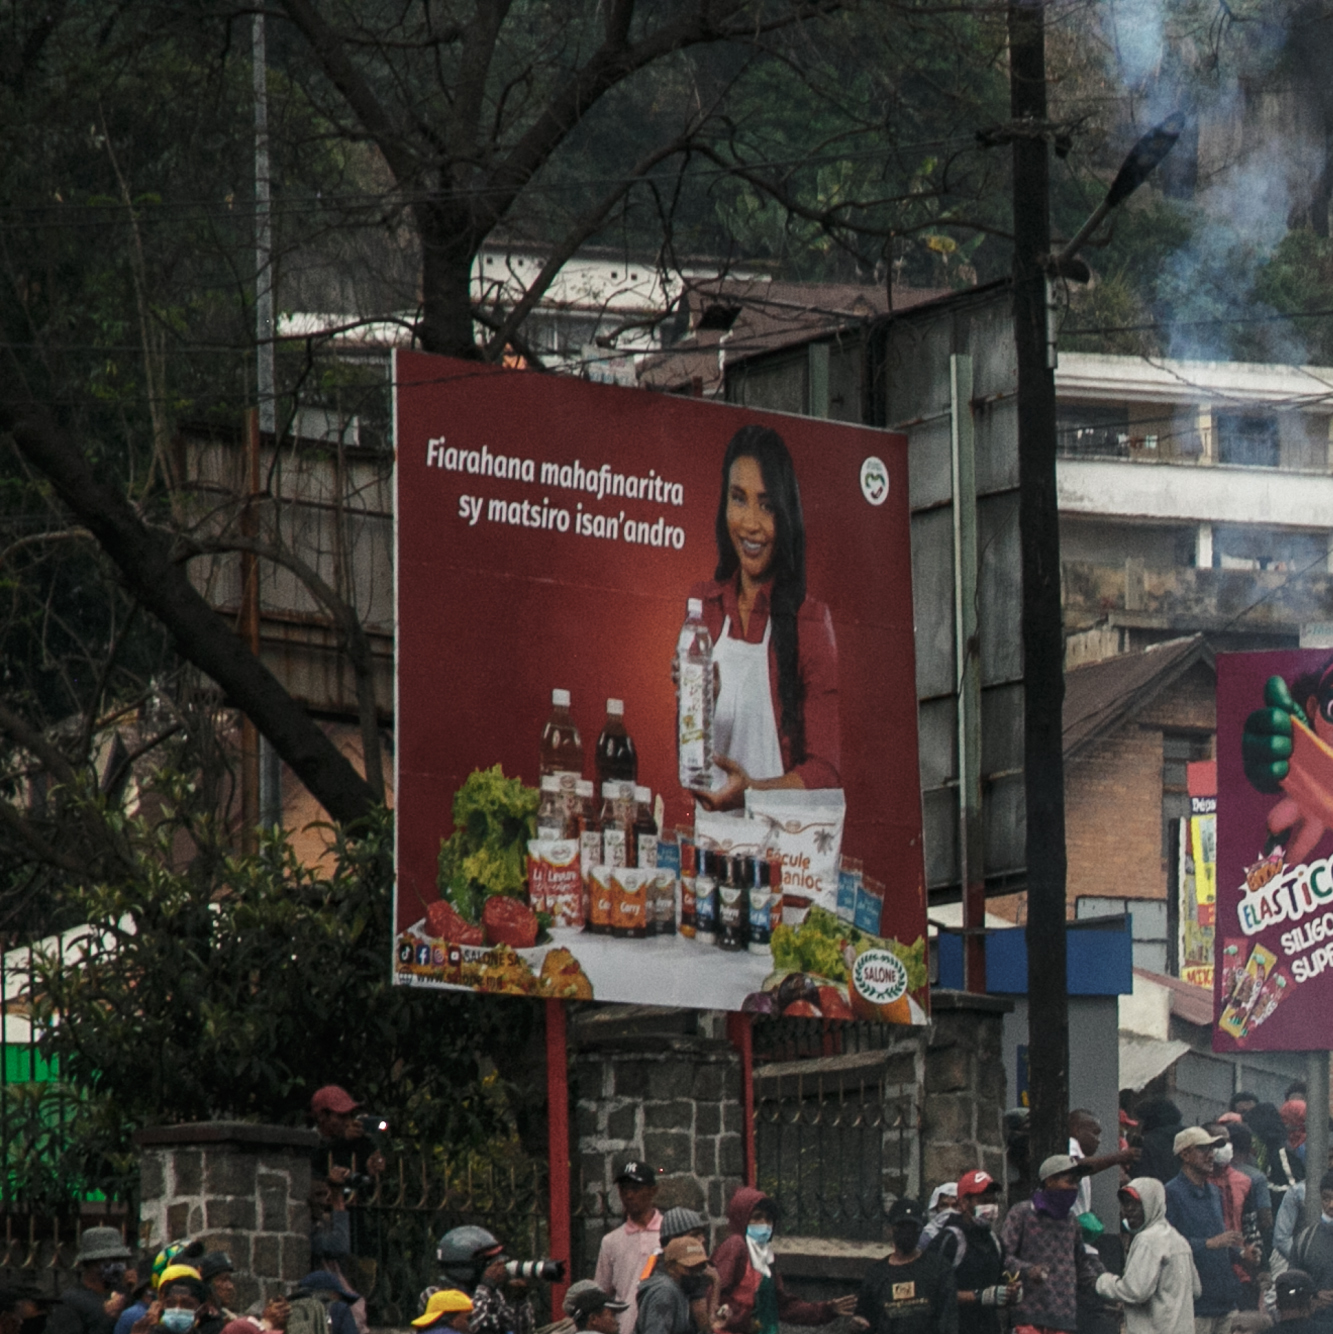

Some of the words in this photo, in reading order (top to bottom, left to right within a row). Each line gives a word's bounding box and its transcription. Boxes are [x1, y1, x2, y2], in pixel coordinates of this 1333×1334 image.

[426, 436, 535, 482] Fiarahana
[540, 460, 684, 506] mahafinaritra
[458, 494, 483, 526] sy
[488, 497, 570, 532] matsiro
[781, 870, 823, 892] anioc
[864, 966, 896, 983] SALONE
